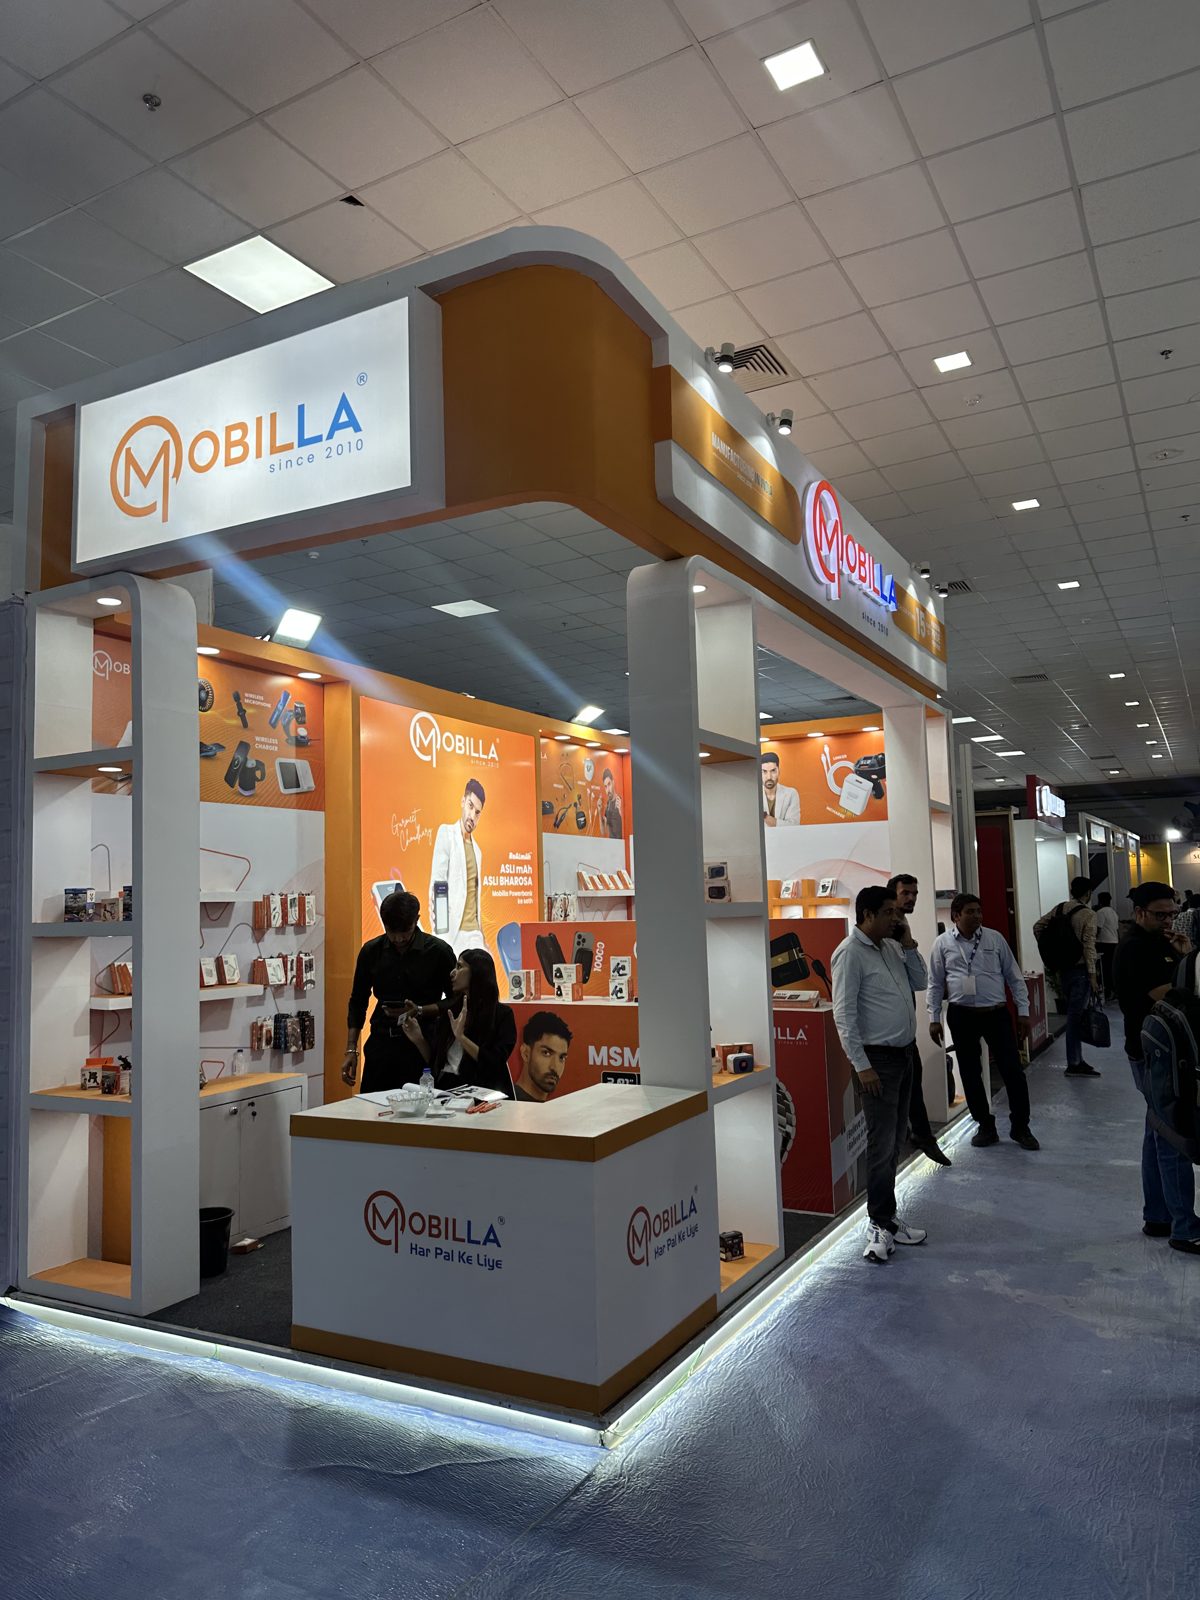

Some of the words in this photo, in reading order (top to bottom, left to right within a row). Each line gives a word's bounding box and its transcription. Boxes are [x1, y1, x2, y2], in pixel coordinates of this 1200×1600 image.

[110, 392, 362, 523] MOBILLA
[269, 454, 315, 473] since
[325, 438, 364, 459] 2010
[806, 479, 897, 611] MOBILLA
[255, 736, 278, 744] WIRELESS
[255, 743, 278, 752] CHARGER
[410, 711, 498, 768] MOBILLA
[483, 875, 499, 886] ASLI
[500, 876, 533, 886] BHAROSA
[500, 863, 516, 874] ASLI
[516, 864, 532, 874] mAh
[364, 1190, 501, 1253] MOBILLA
[627, 1196, 697, 1267] MOBILLA
[410, 1243, 430, 1257] Har
[435, 1247, 454, 1262] Pal
[477, 1253, 502, 1271] Liye
[654, 1244, 665, 1260] Har
[667, 1234, 677, 1251] Pal
